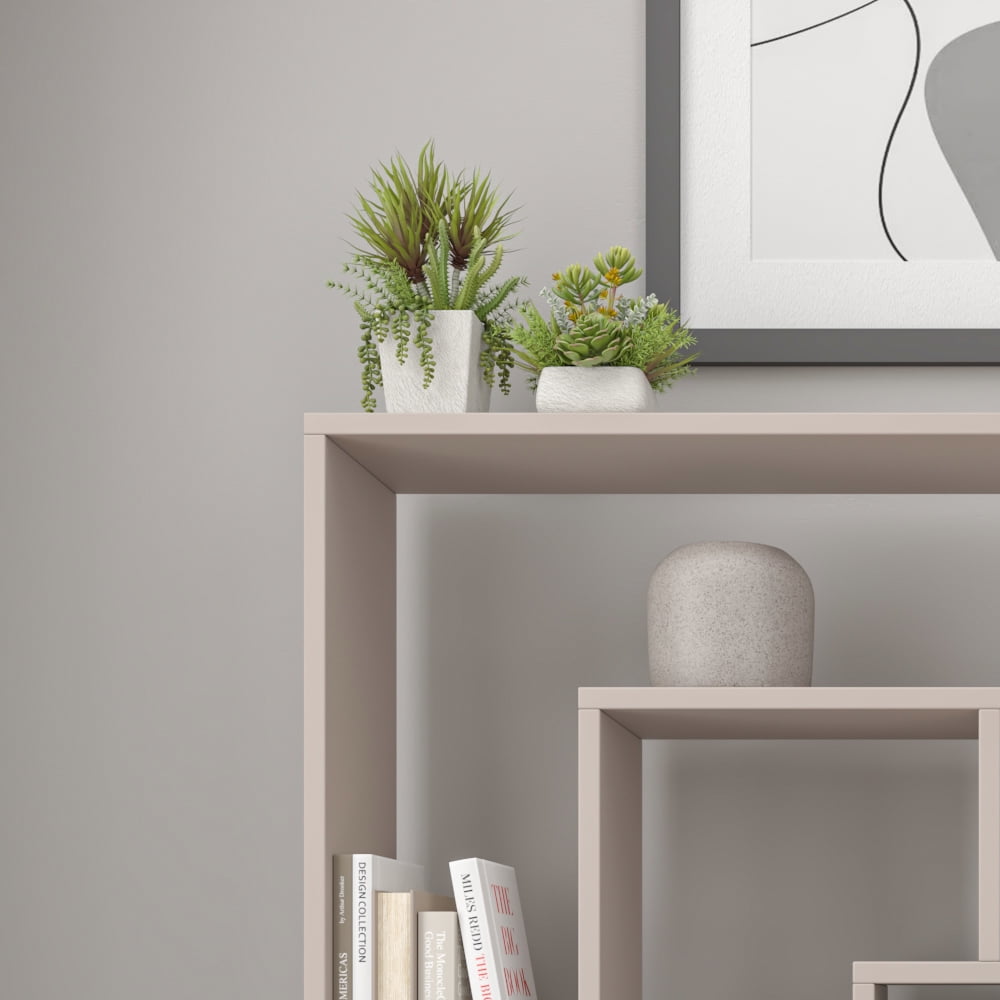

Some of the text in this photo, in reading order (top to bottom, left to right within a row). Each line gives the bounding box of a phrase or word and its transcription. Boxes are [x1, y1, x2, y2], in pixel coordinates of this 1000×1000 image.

[461, 873, 477, 912] MILES
[491, 884, 514, 916] THE
[358, 862, 367, 963] DESIGN COLLECTION
[424, 931, 434, 958] Good
[436, 930, 446, 951] The
[468, 915, 483, 951] REDD
[475, 953, 489, 981] THE
[503, 968, 531, 997] BOOK
